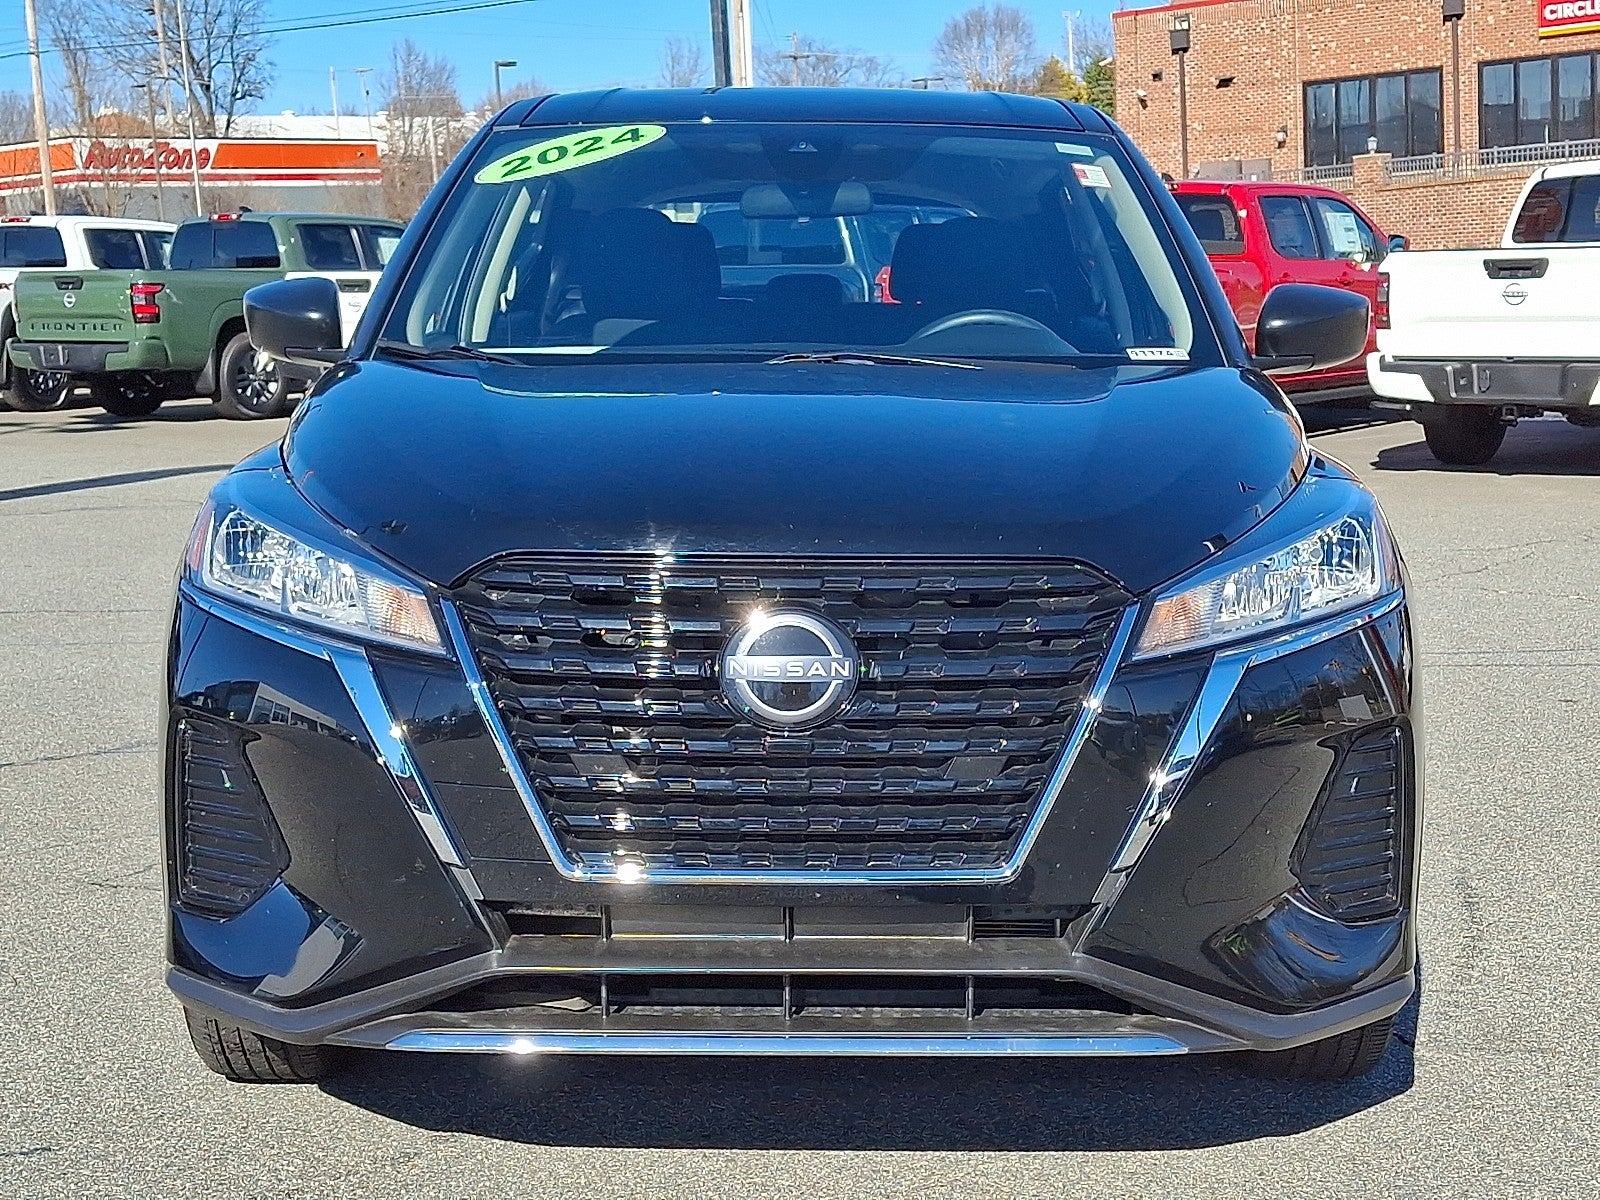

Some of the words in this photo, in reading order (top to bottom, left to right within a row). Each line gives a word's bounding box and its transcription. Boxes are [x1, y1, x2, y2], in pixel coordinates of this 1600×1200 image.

[83, 140, 210, 169] AutoZone
[501, 128, 644, 178] 2024
[30, 322, 123, 332] FRONTIER
[729, 660, 850, 677] NISSAN
